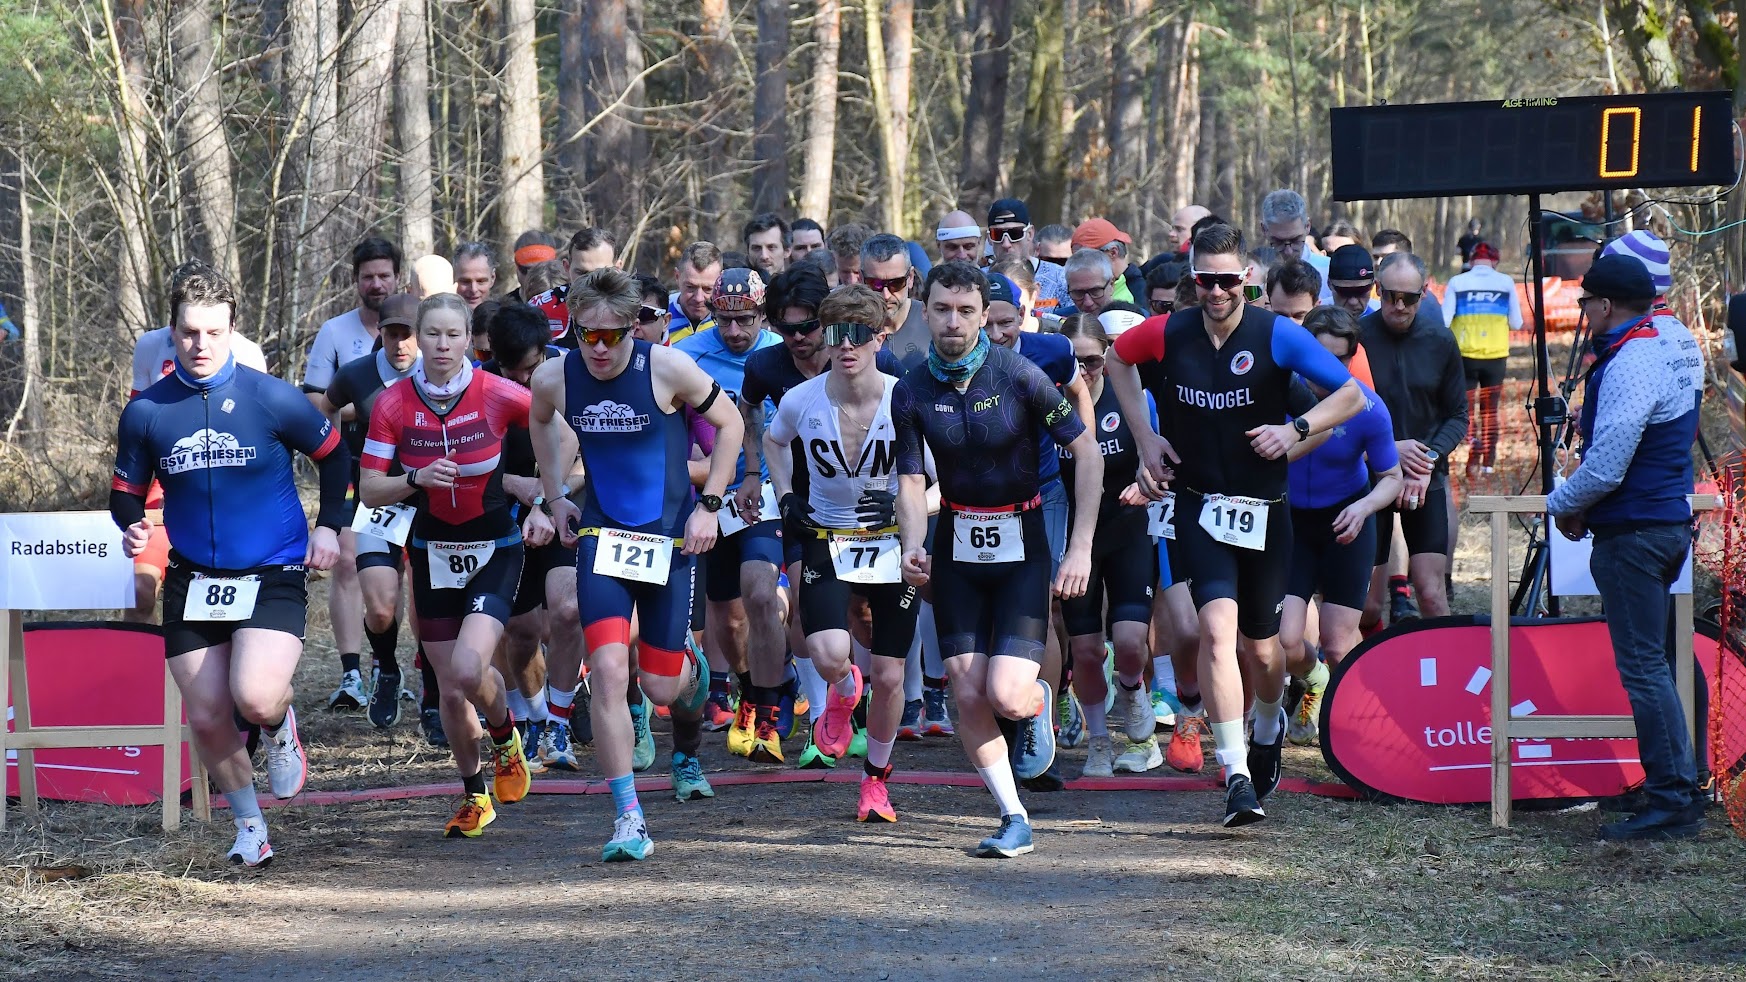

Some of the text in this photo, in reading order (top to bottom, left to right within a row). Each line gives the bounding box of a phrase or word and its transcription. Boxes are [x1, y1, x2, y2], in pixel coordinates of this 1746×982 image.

[1467, 291, 1502, 303] HRV
[1176, 384, 1255, 410] ZUGVOGEL
[934, 403, 955, 413] GOBIK
[573, 415, 650, 427] BSV FRIESEN
[410, 438, 423, 447] TuS
[461, 431, 485, 444] Berlin
[160, 447, 256, 470] BSV FRIESEN
[169, 458, 244, 473] TRIATHLON
[370, 508, 396, 528] 57
[1212, 505, 1254, 533] 119
[970, 526, 1001, 549] 65
[11, 539, 108, 558] Radabstieg
[612, 543, 655, 569] 121
[849, 547, 880, 569] 77
[448, 555, 479, 574] 80
[205, 584, 237, 606] 88
